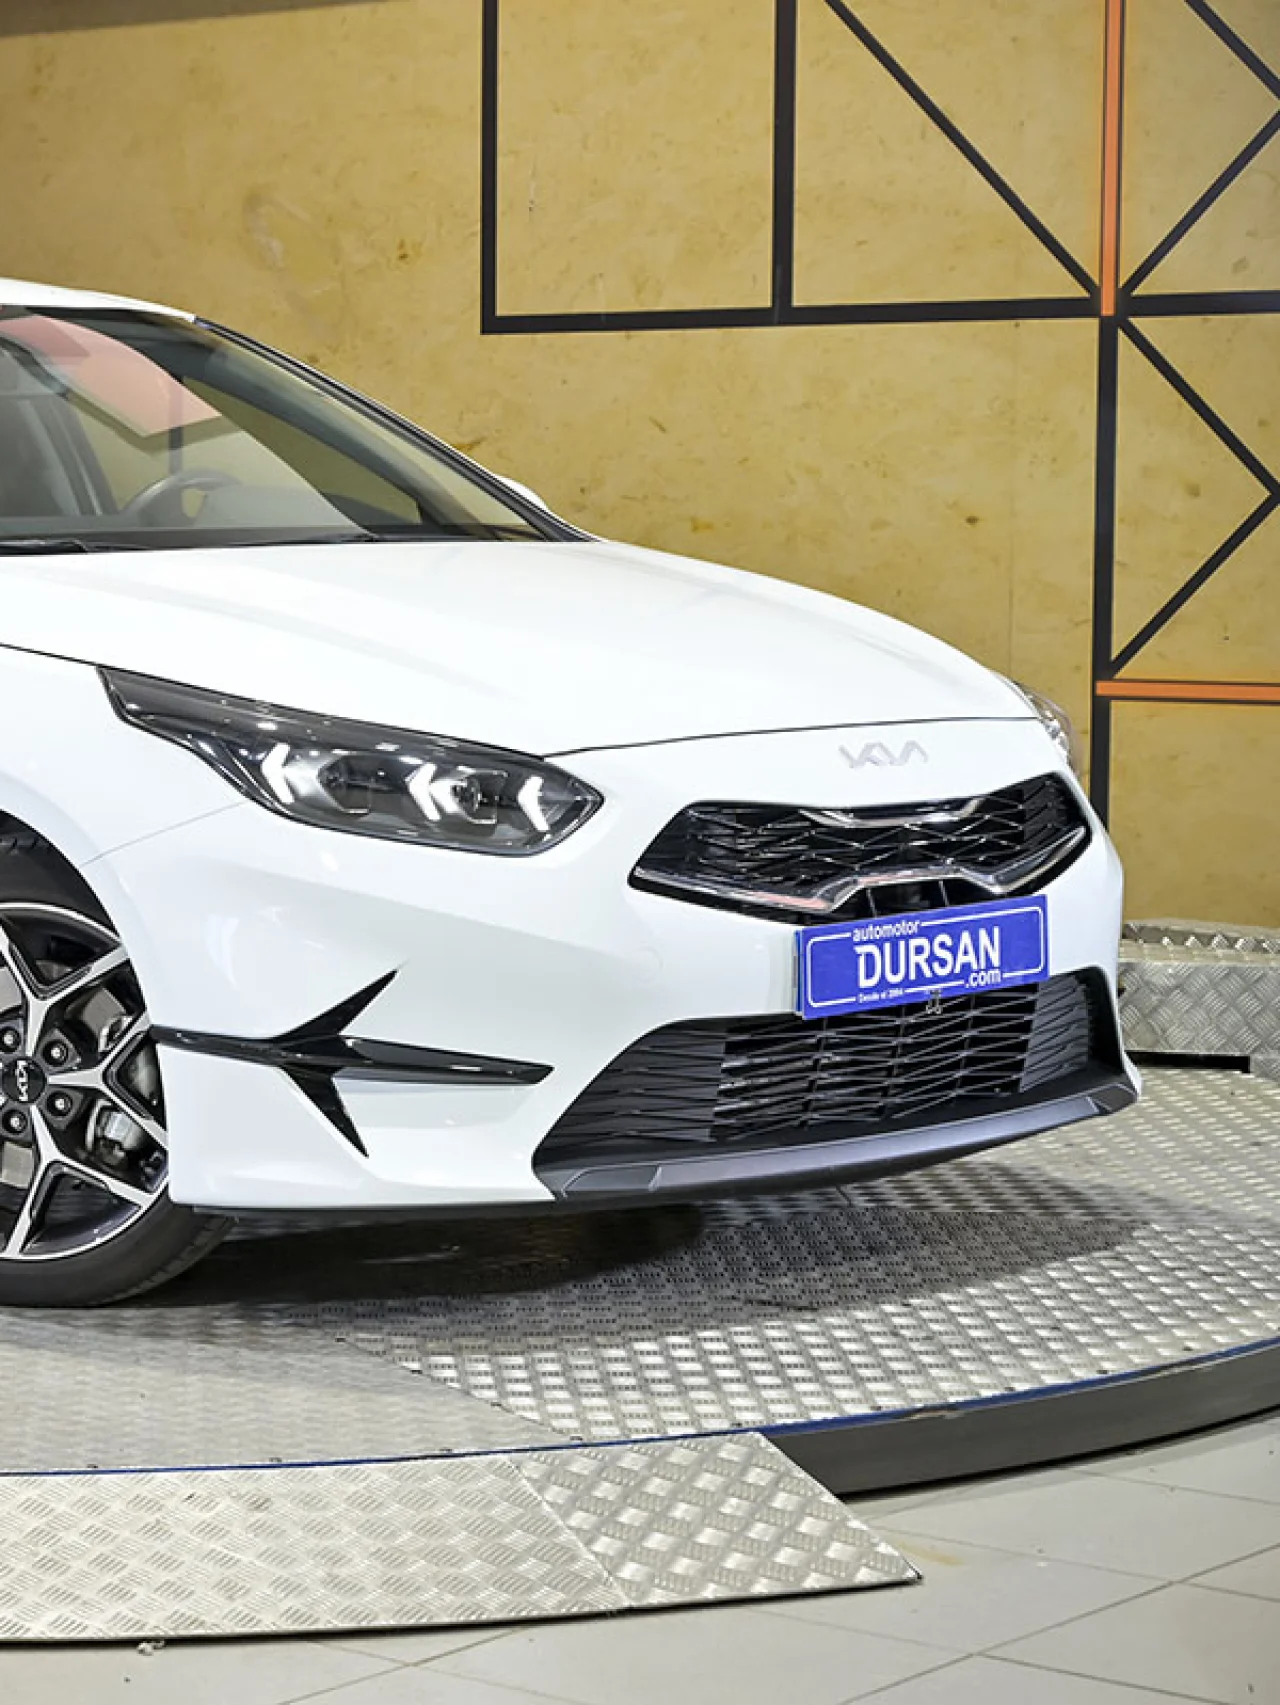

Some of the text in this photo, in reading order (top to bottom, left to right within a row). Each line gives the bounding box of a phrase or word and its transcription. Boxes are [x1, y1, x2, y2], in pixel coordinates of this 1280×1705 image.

[852, 919, 920, 942] automotor
[854, 926, 1000, 988] DURSAN
[965, 968, 1001, 989] .com
